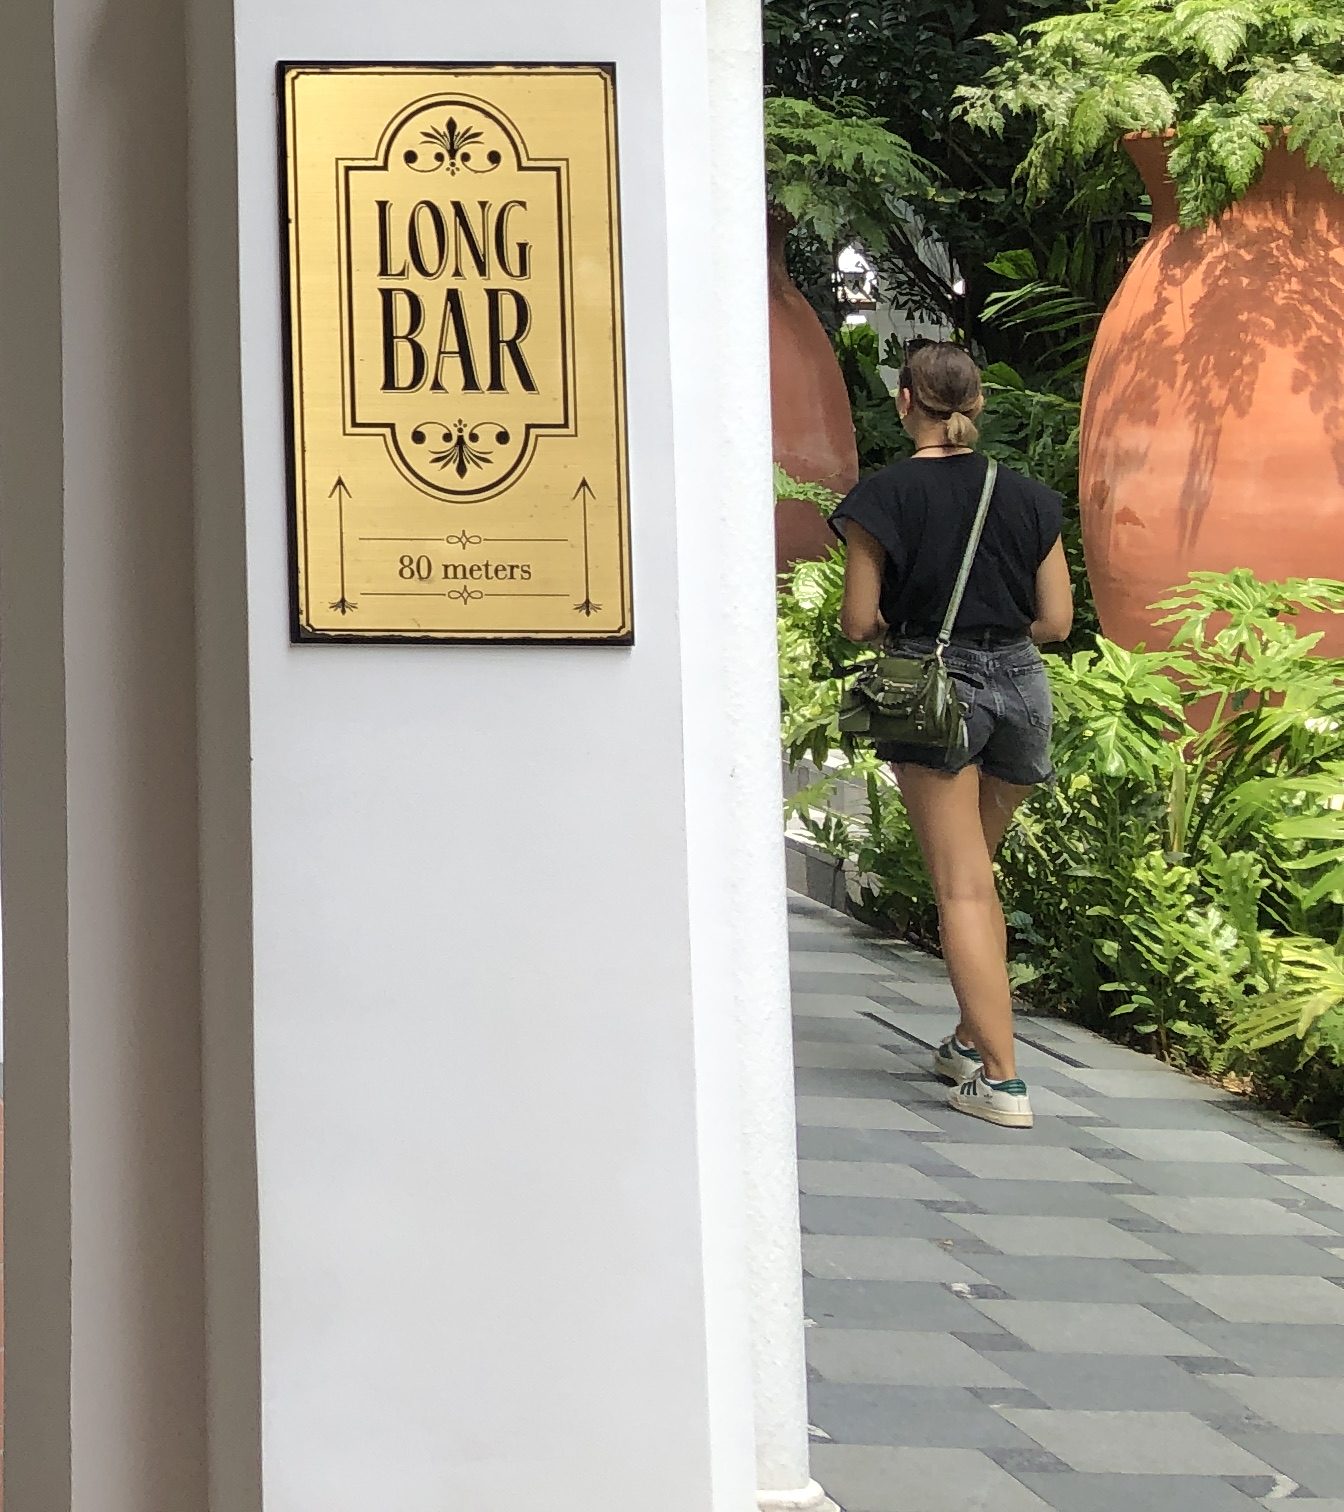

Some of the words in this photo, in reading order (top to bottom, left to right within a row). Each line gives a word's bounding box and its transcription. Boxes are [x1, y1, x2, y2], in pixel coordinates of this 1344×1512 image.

[373, 199, 533, 281] LONG
[377, 287, 540, 396] BAR
[397, 554, 433, 582] 80
[440, 556, 533, 582] meters
